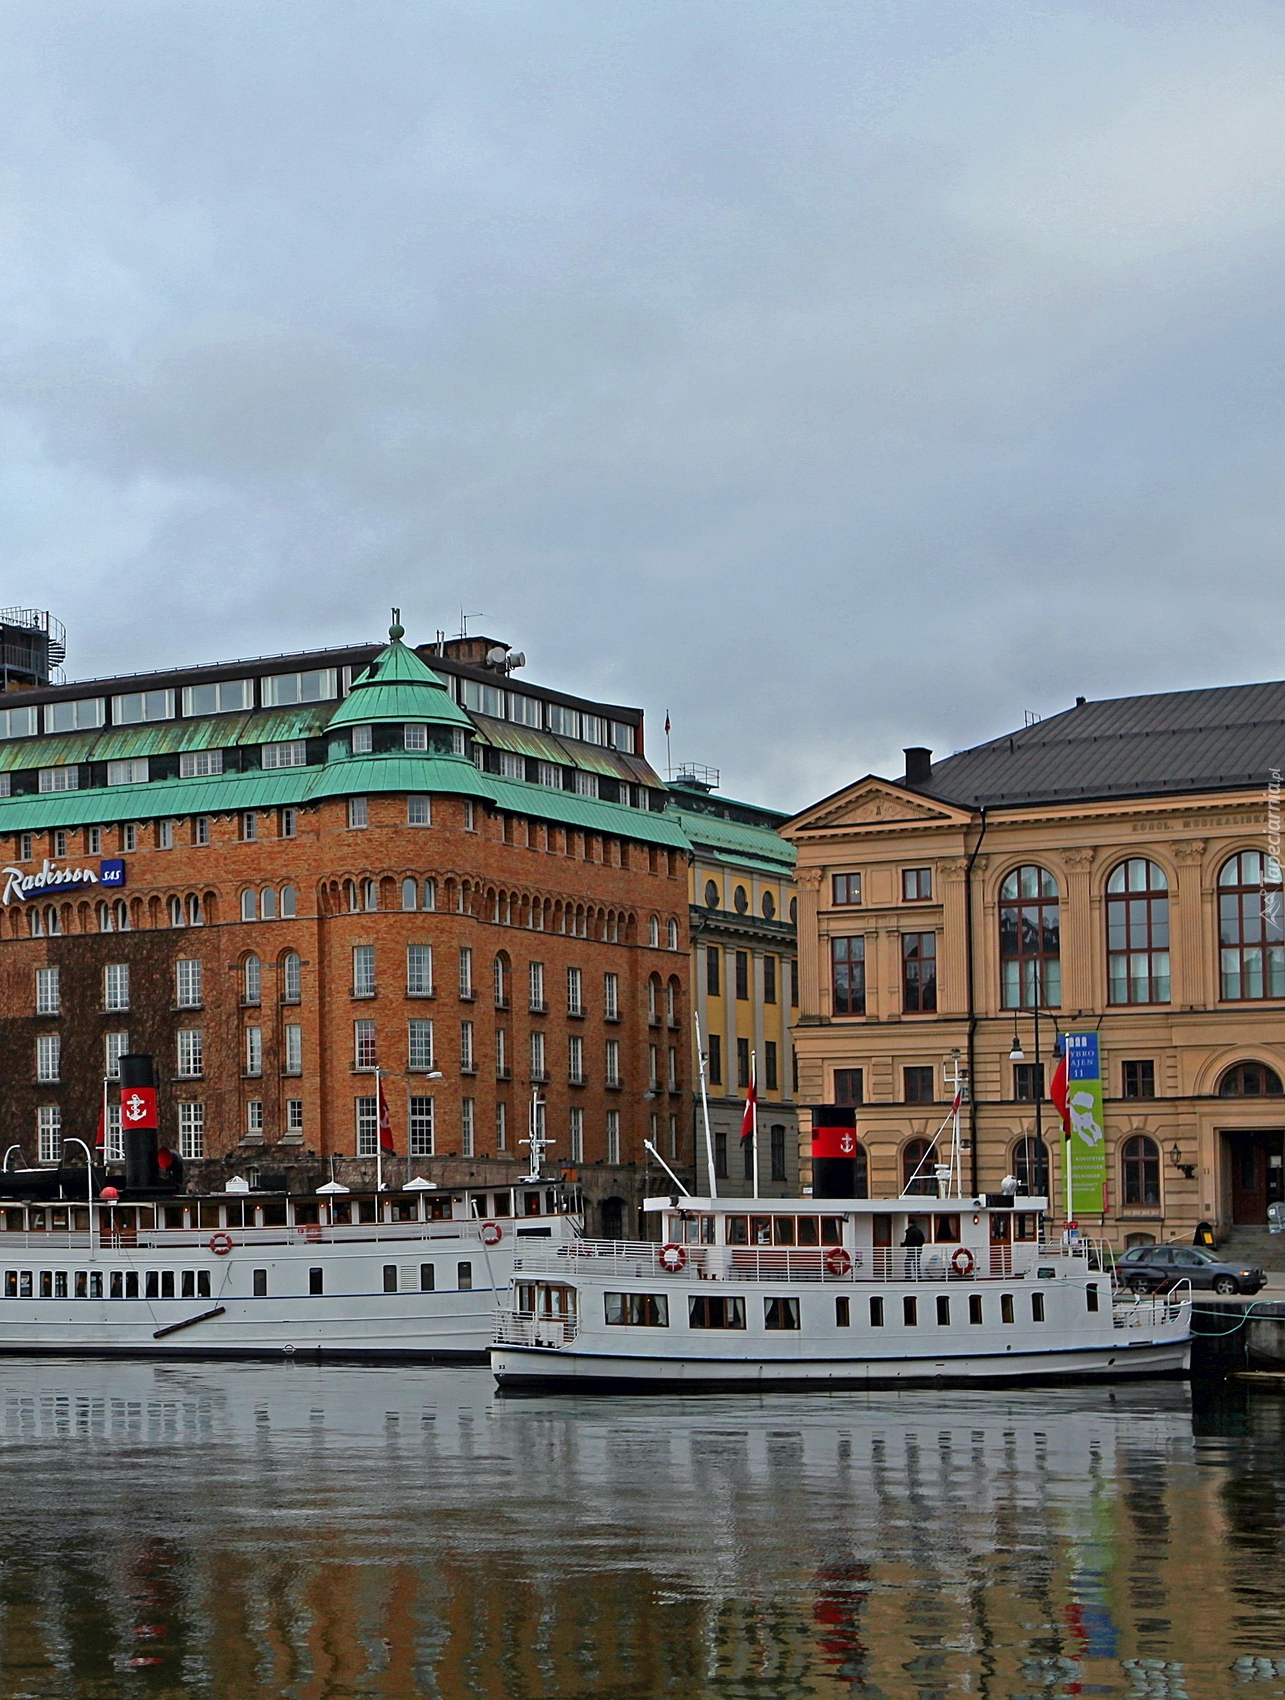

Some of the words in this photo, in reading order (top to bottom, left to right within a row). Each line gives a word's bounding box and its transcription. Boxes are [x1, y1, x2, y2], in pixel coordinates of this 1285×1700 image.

[1, 859, 99, 906] Radisson
[102, 870, 121, 881] SAS
[1070, 1059, 1094, 1068] AJEN
[1074, 1069, 1084, 1077] 11
